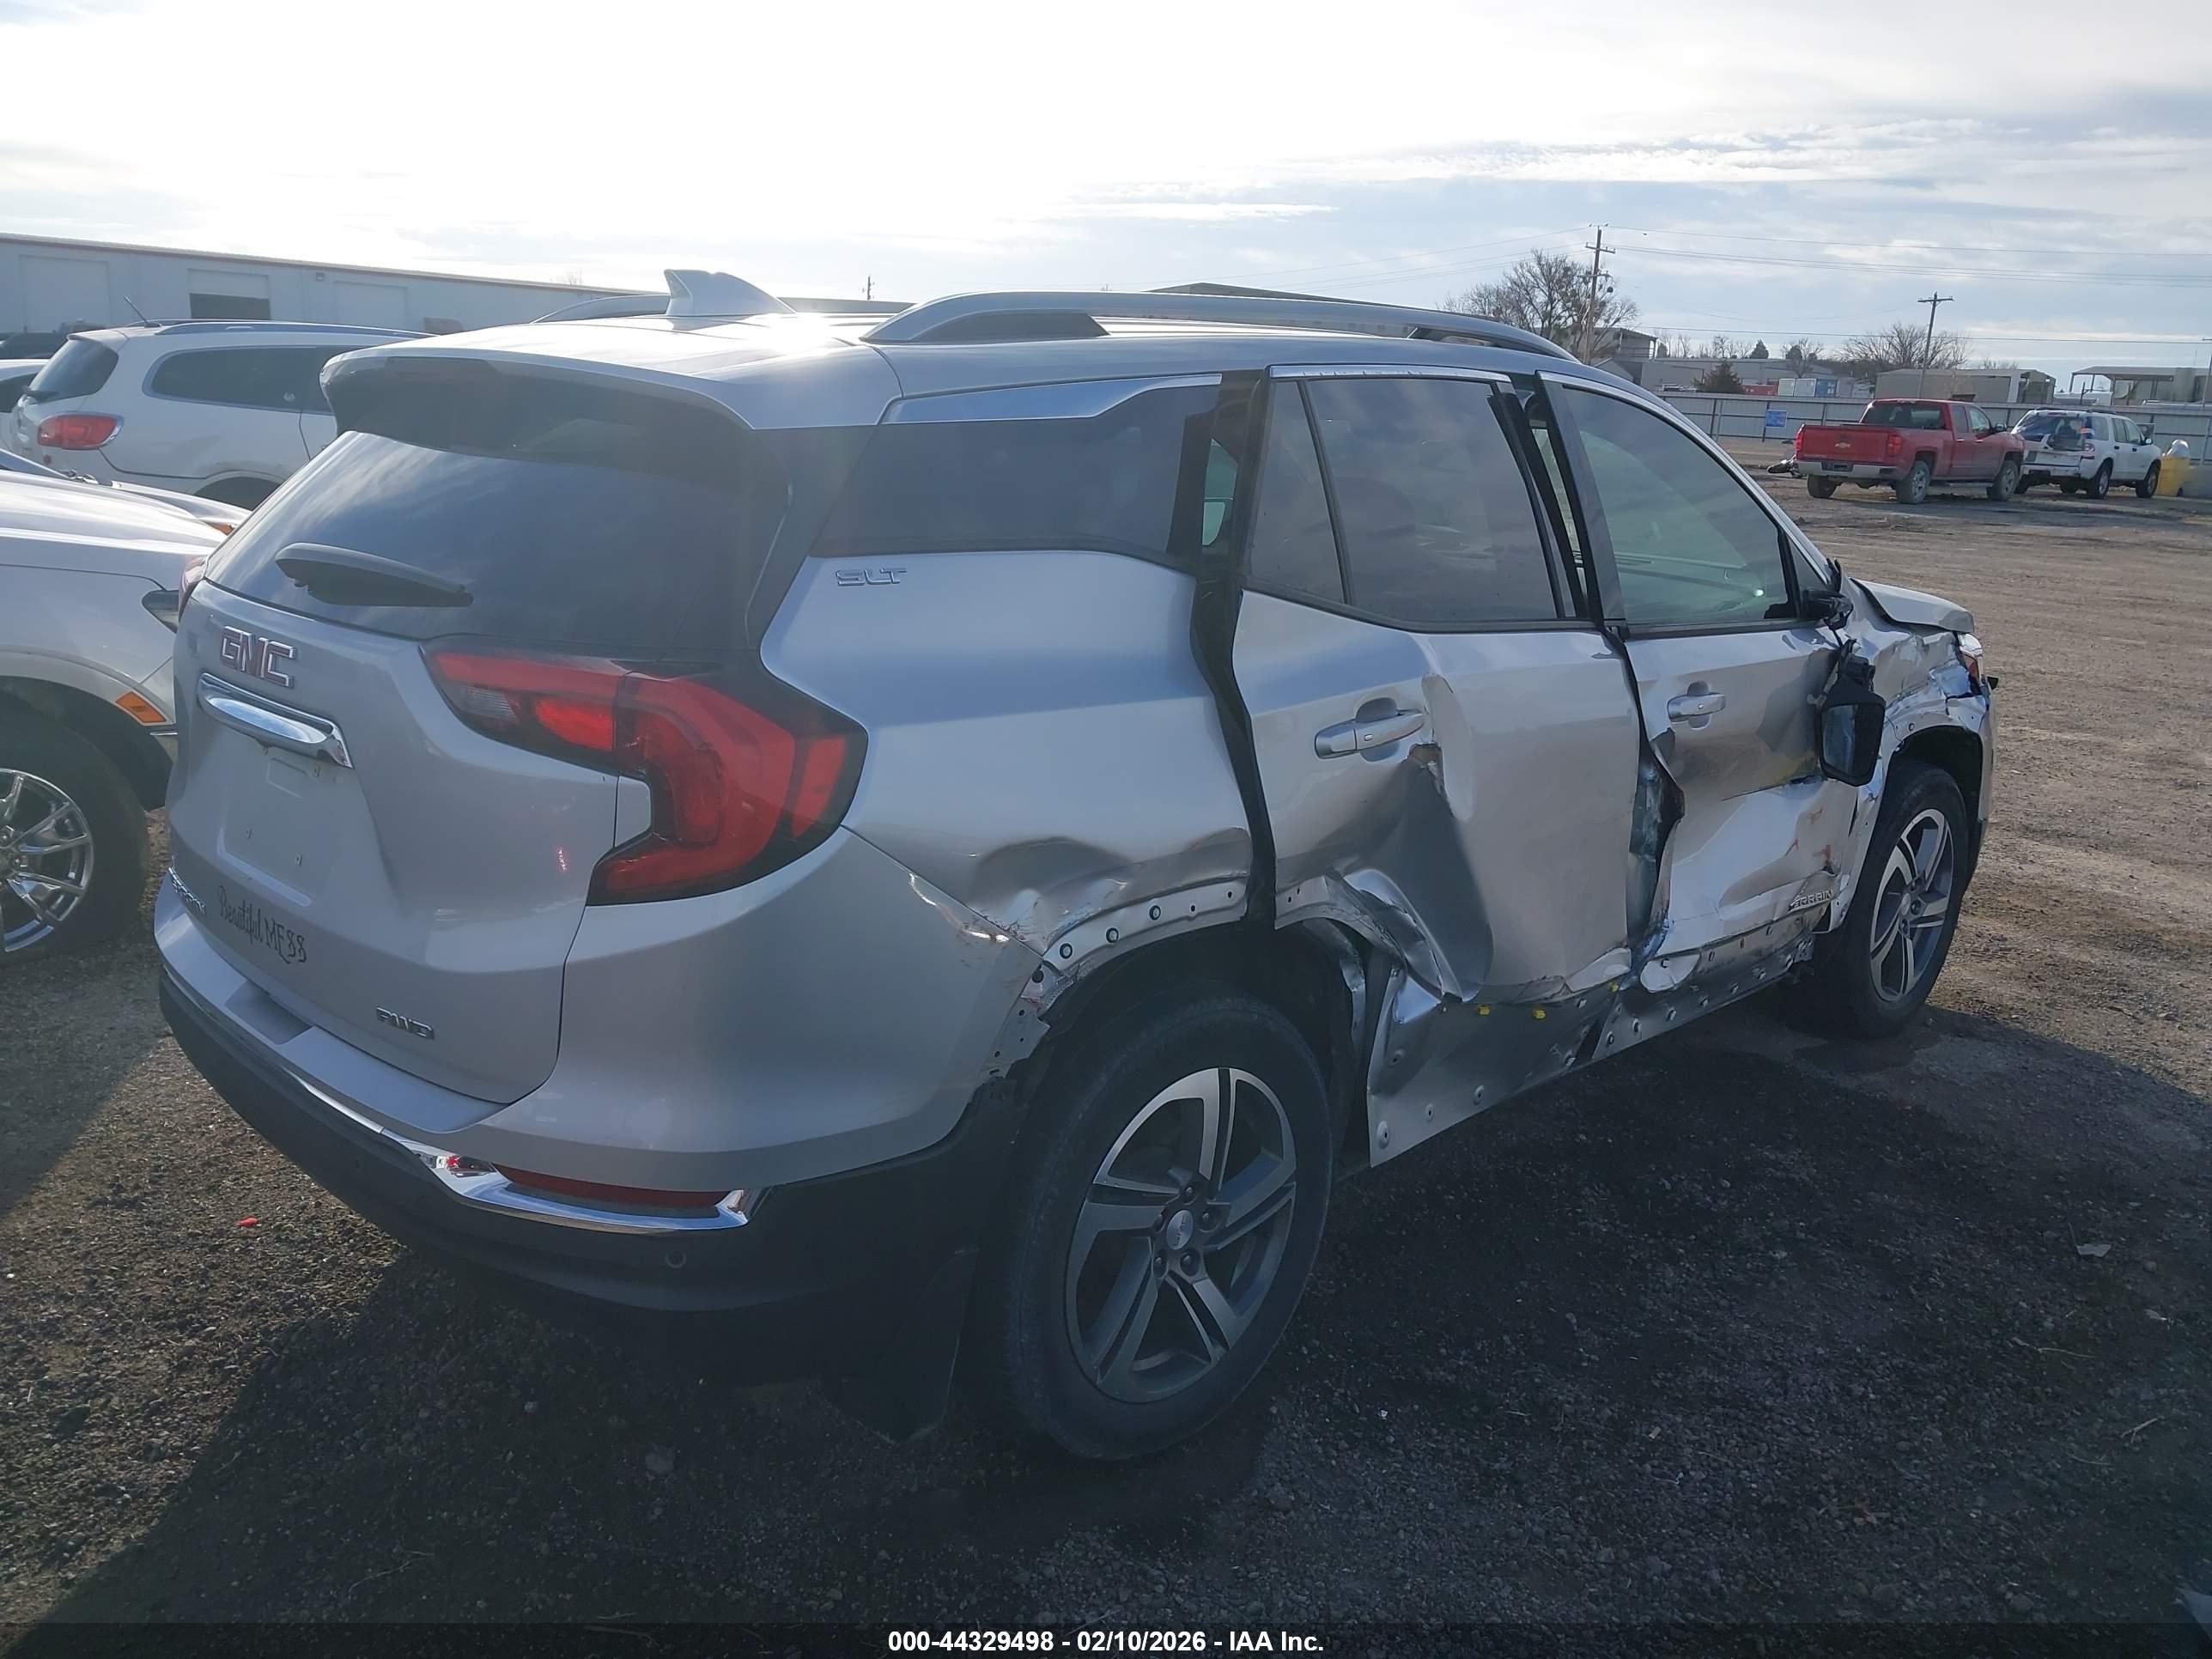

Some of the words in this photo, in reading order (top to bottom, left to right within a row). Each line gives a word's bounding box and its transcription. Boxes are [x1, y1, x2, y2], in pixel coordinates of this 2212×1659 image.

[836, 568, 907, 587] SLT
[220, 625, 295, 689] GMC
[217, 885, 263, 944] Beautiful
[376, 1006, 434, 1041] AWD
